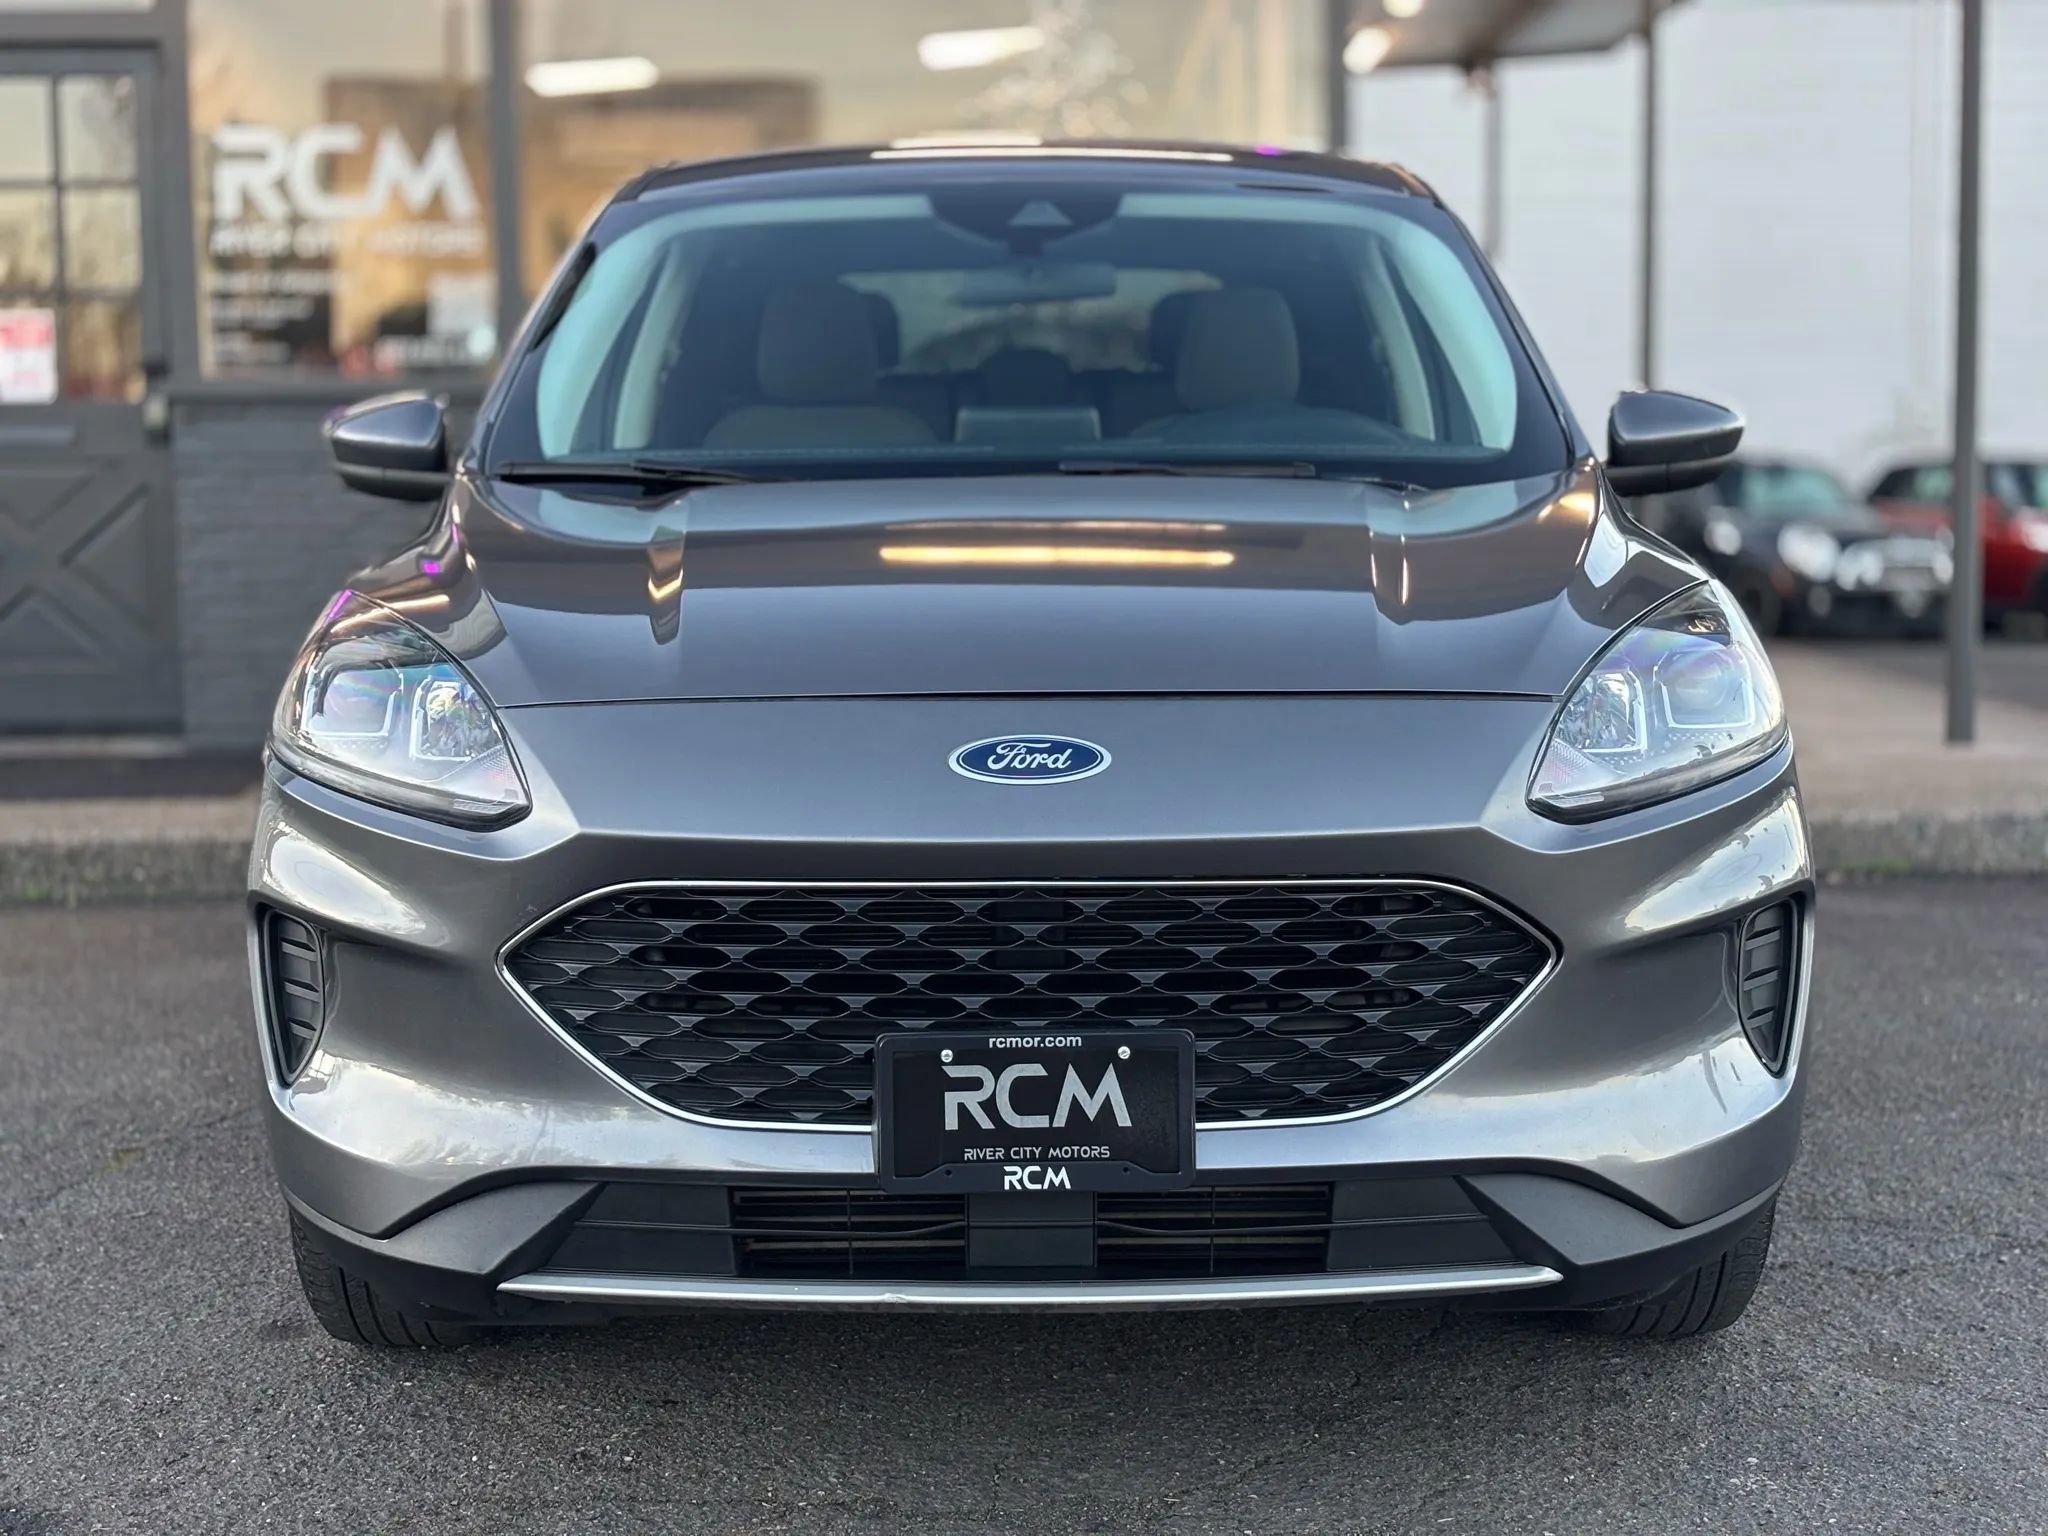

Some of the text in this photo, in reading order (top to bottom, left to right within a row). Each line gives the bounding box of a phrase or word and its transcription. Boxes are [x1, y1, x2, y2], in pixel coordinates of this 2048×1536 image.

[212, 124, 478, 219] RCM
[987, 742, 1073, 770] Ford
[988, 1036, 1082, 1048] rcmor.com
[942, 1063, 1132, 1130] RCM
[964, 1146, 1110, 1160] RIVER CITY MOTORS
[1003, 1165, 1071, 1190] RCM
